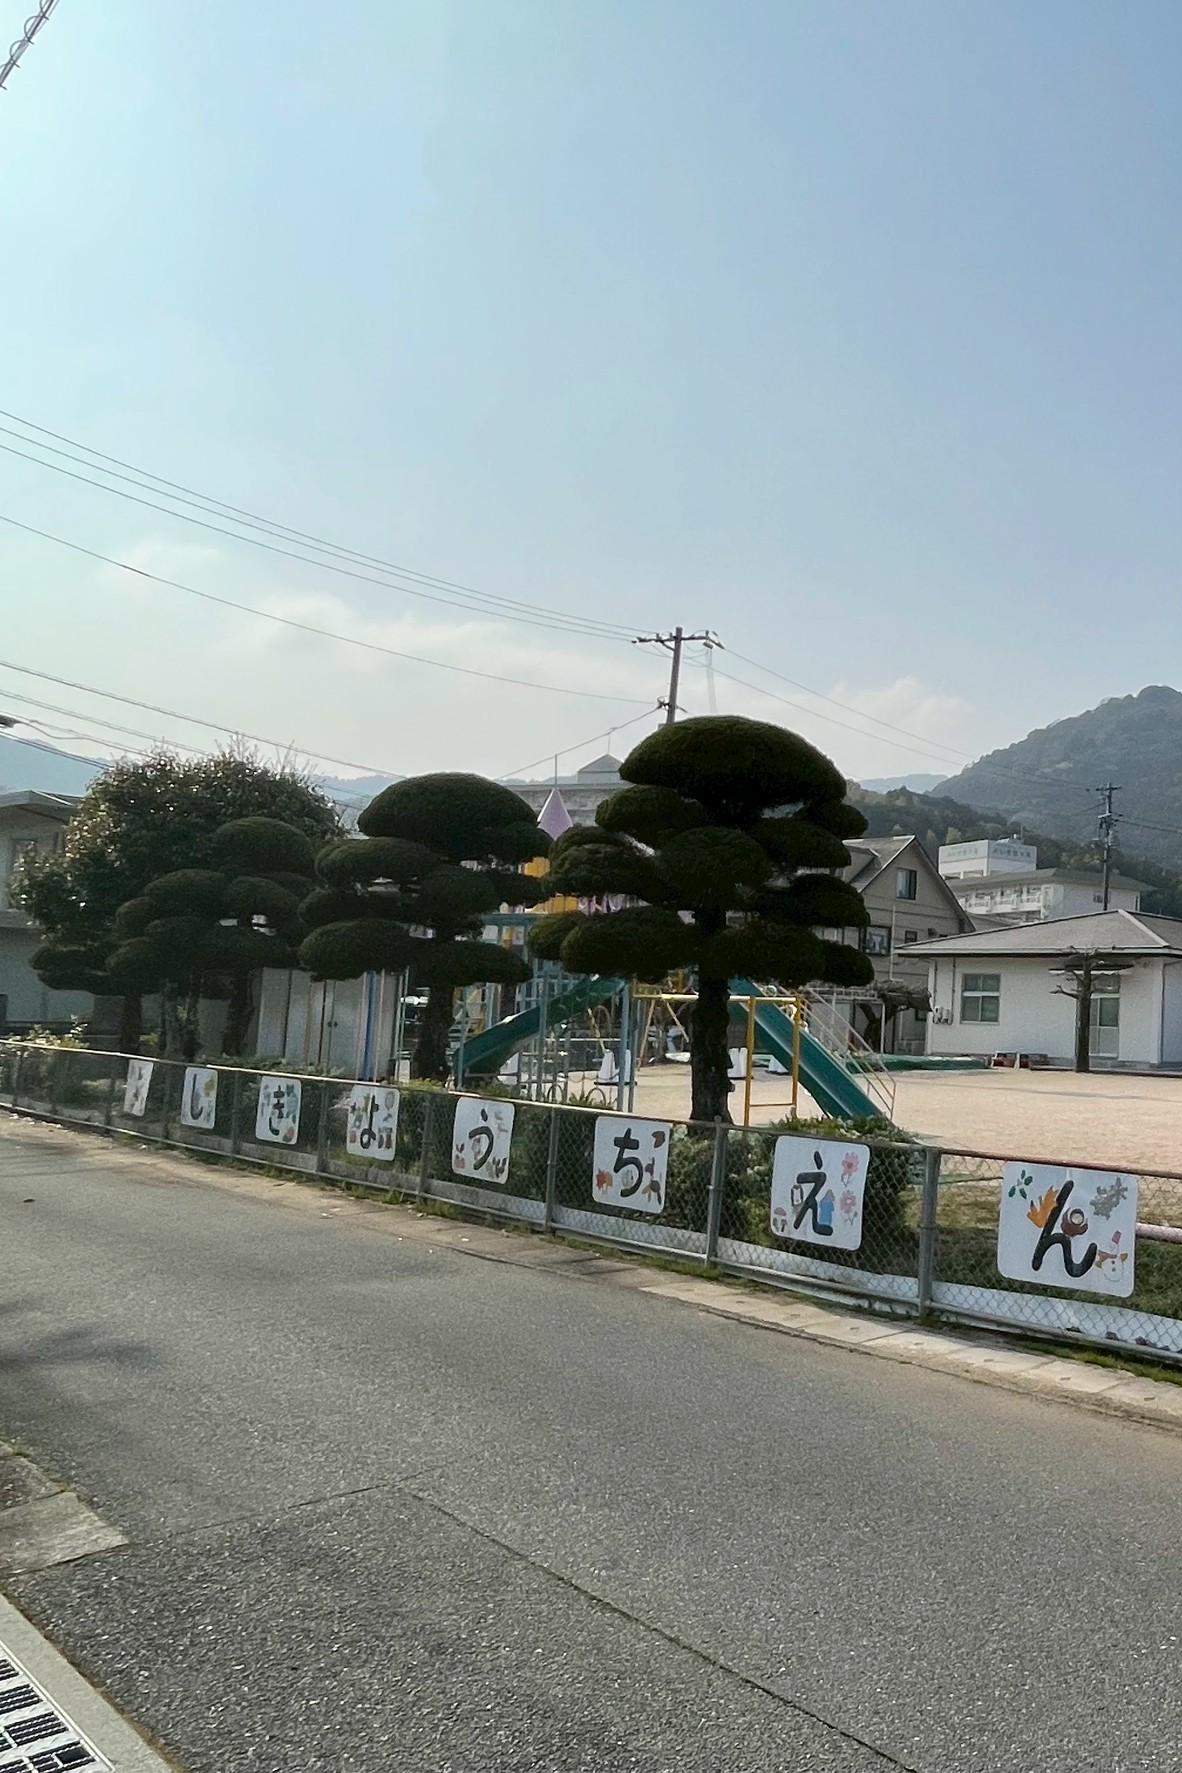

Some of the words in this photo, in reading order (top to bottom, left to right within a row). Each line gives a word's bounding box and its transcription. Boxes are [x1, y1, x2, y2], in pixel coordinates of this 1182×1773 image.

[190, 1073, 204, 1120] し
[268, 1085, 286, 1136] き
[360, 1094, 380, 1149] よ
[468, 1108, 494, 1171] う
[613, 1127, 643, 1198] ち
[794, 1150, 834, 1236] え
[1031, 1179, 1098, 1278] ん
